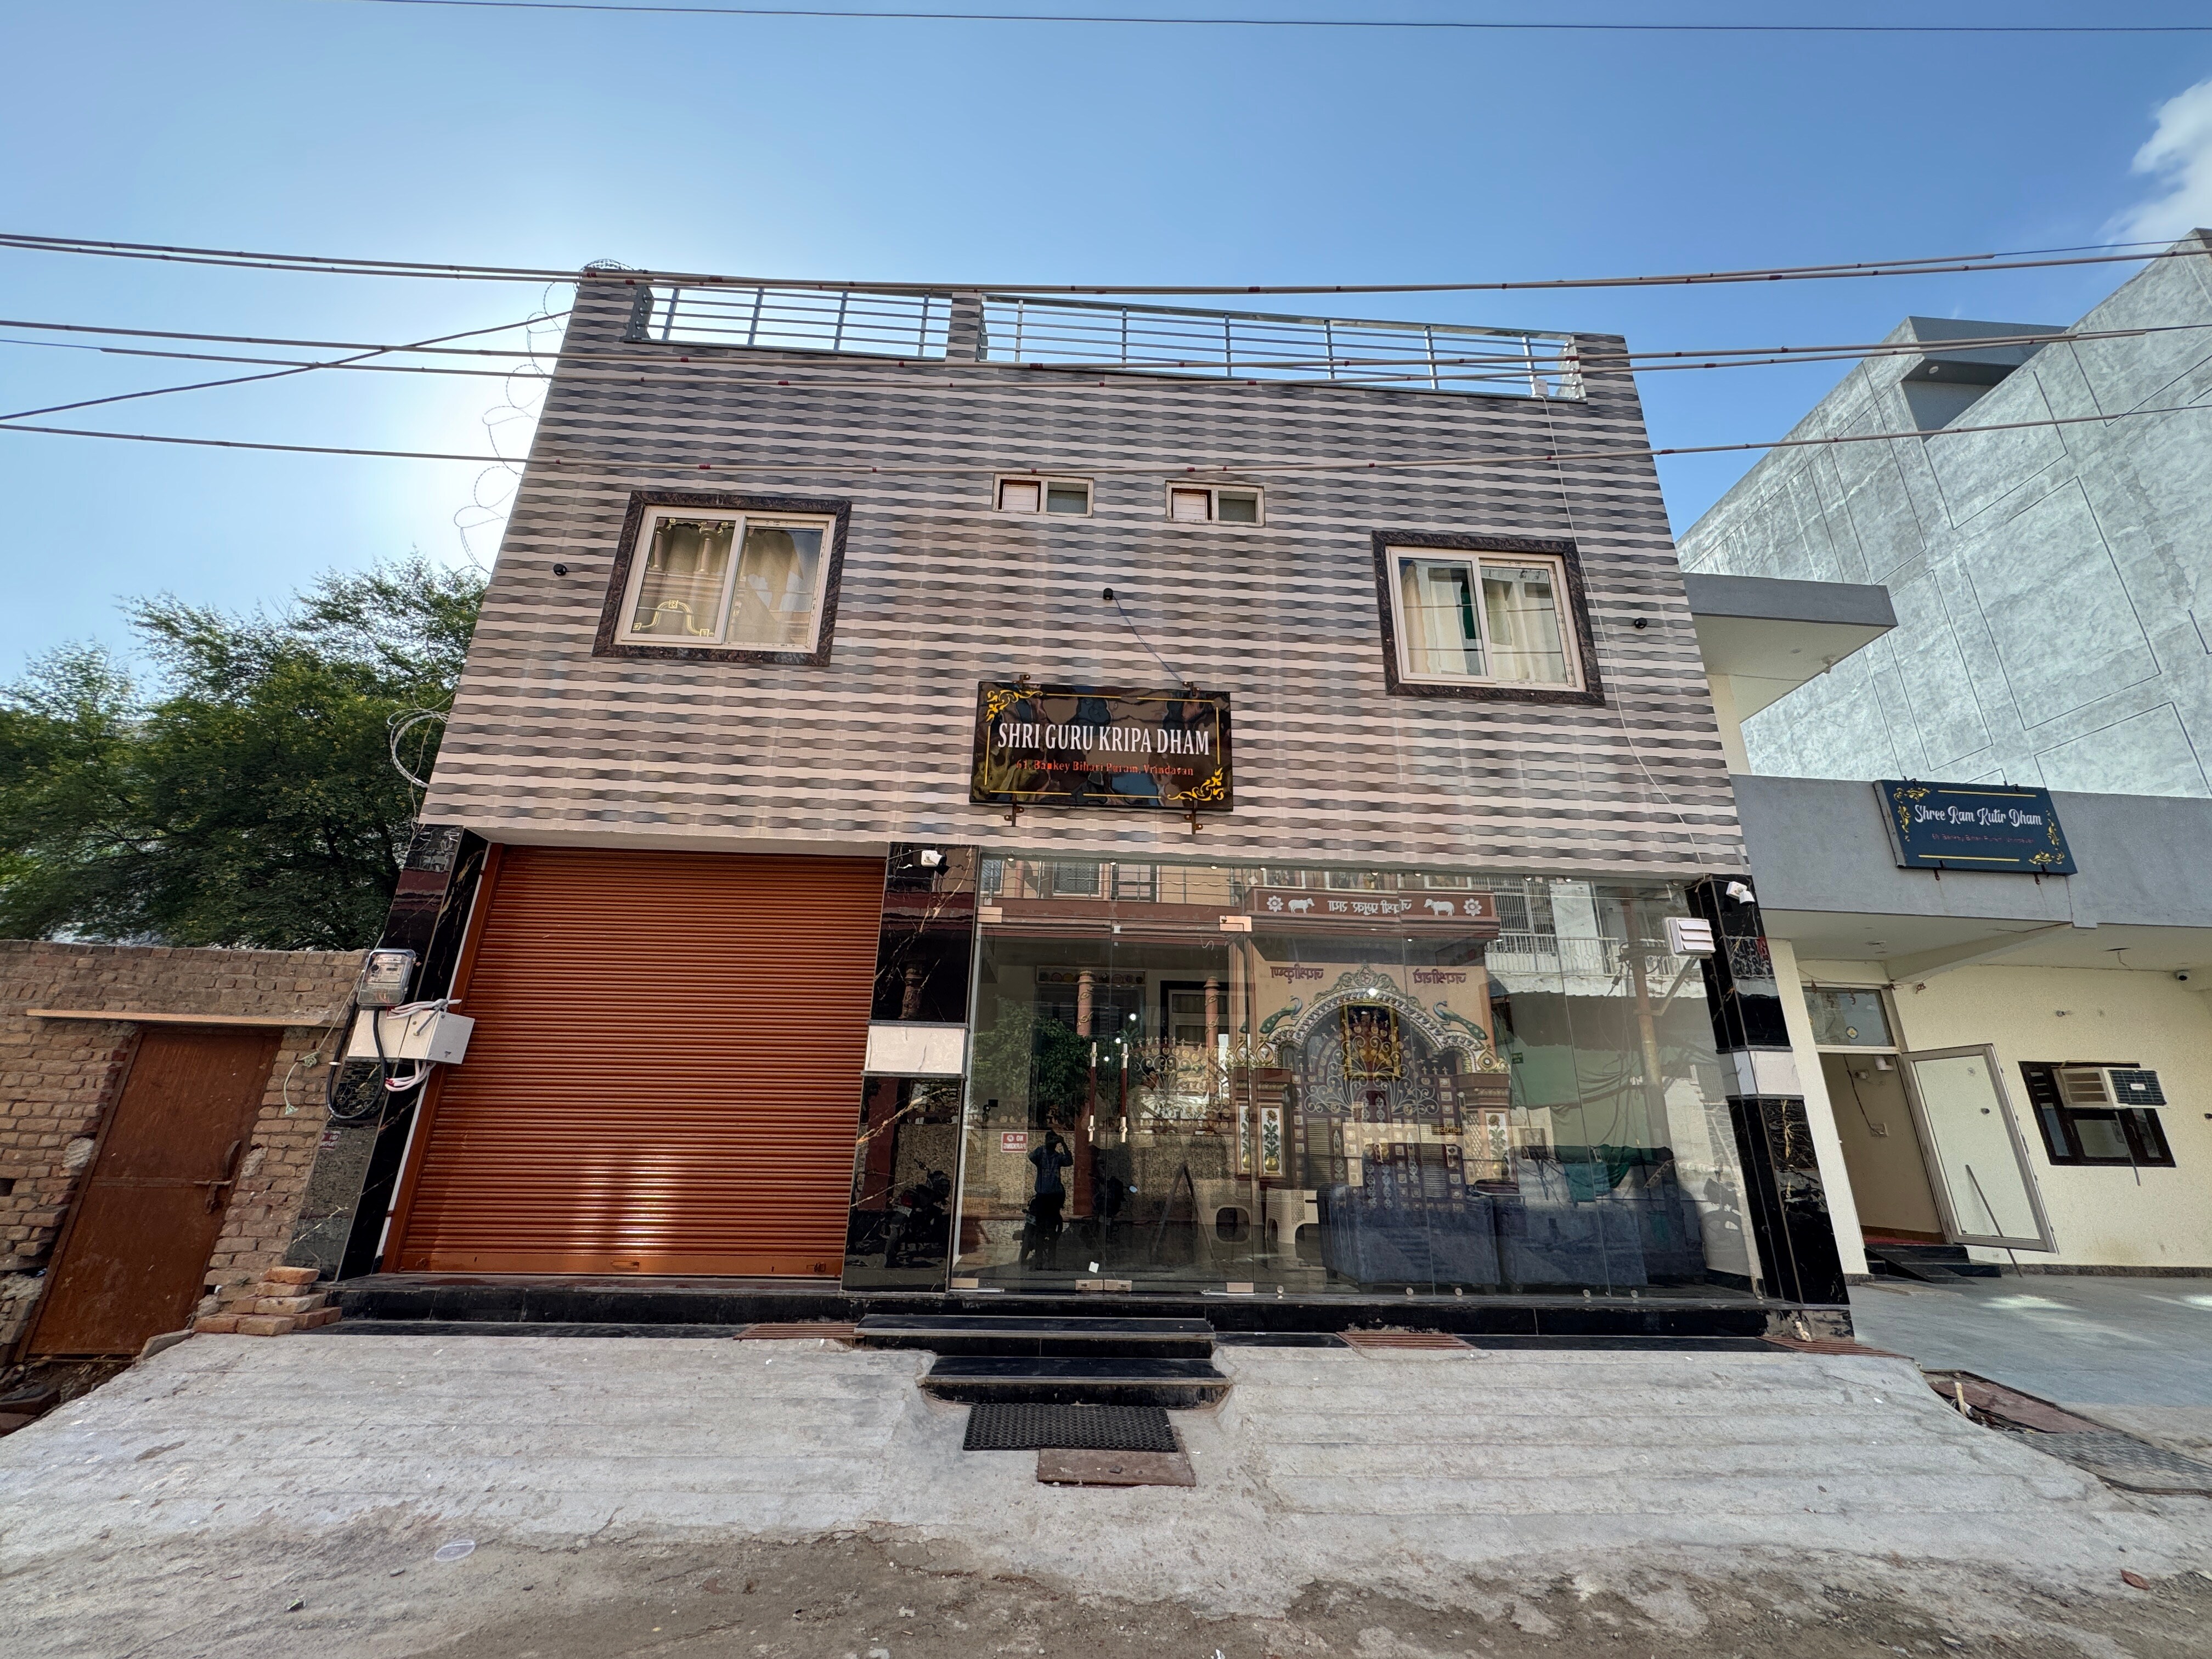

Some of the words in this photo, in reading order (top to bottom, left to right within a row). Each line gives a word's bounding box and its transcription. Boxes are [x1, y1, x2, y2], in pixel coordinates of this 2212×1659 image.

[998, 723, 1041, 749] SHRI
[1045, 724, 1094, 751] GURU
[1098, 726, 1152, 753] KRIPA
[1156, 729, 1210, 755] DHAM
[1073, 760, 1103, 772] Bihari
[1143, 764, 1194, 776] Vrindavan
[1914, 804, 1946, 823] Shree
[1948, 806, 1975, 825] Ram
[1977, 808, 2006, 826] Kutir
[2008, 809, 2042, 827] Dham
